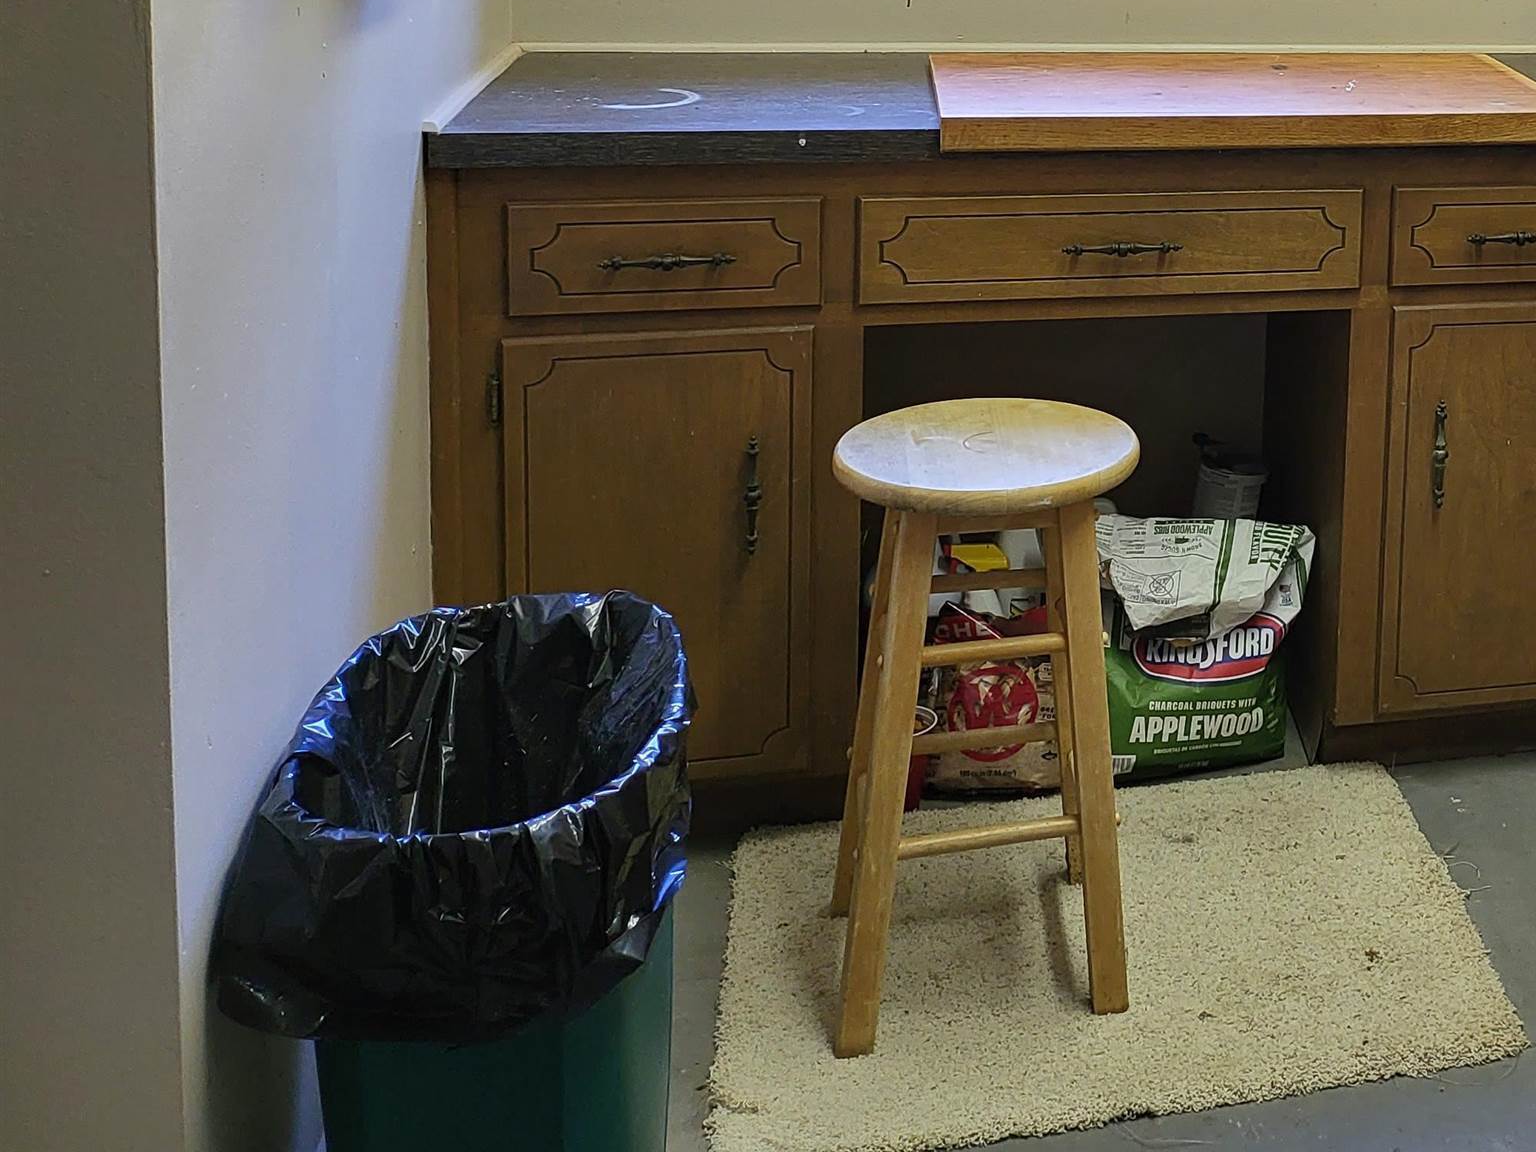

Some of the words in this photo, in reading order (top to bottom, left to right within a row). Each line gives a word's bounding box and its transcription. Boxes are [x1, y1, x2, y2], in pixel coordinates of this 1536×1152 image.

[1170, 525, 1214, 535] APPLEWOOD
[1149, 701, 1194, 711] CHARCOAL
[1195, 700, 1237, 710] BRIQUETS
[1129, 707, 1264, 743] APPLEWOOD
